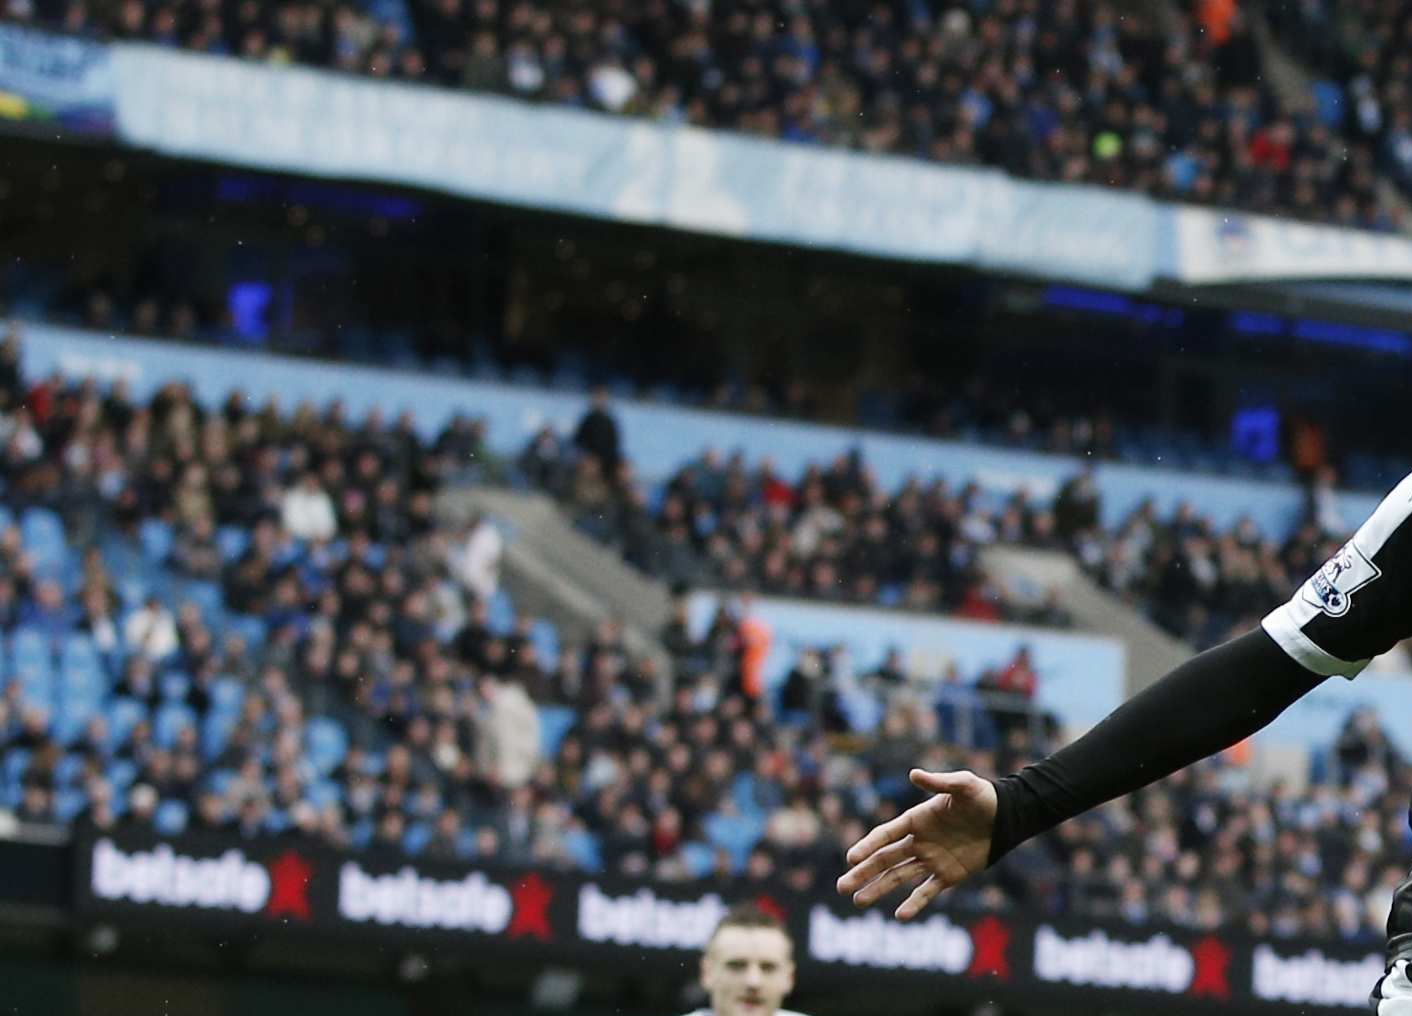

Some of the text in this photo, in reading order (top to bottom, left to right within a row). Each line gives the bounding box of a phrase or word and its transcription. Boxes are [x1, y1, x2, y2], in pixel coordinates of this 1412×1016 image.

[92, 839, 271, 913] betsafe
[339, 862, 513, 933] betsafe
[808, 906, 973, 973] betsafe
[1034, 928, 1194, 993] betsafe
